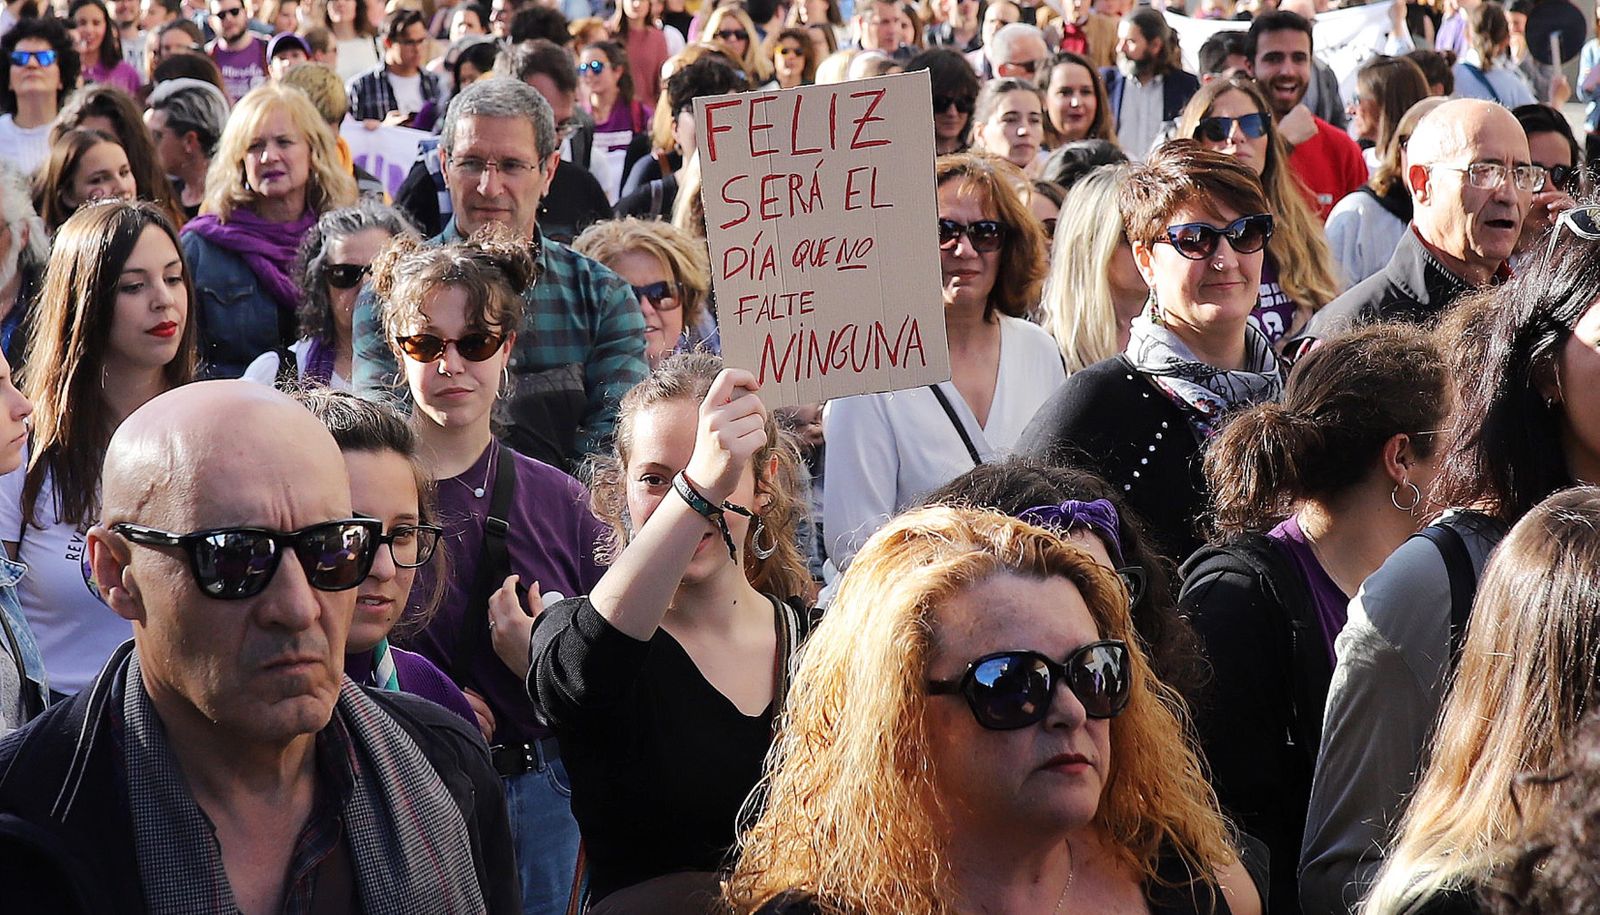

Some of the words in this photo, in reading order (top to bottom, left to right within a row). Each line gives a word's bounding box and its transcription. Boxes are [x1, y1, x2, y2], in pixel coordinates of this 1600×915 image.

[705, 88, 892, 161] FELIZ
[720, 159, 824, 229] SERÁ
[845, 167, 893, 210] EL
[723, 231, 776, 280] DÍA
[792, 237, 836, 272] QUE
[835, 238, 873, 266] NO
[733, 291, 815, 325] FALTE
[758, 314, 926, 385] NINGUNA
